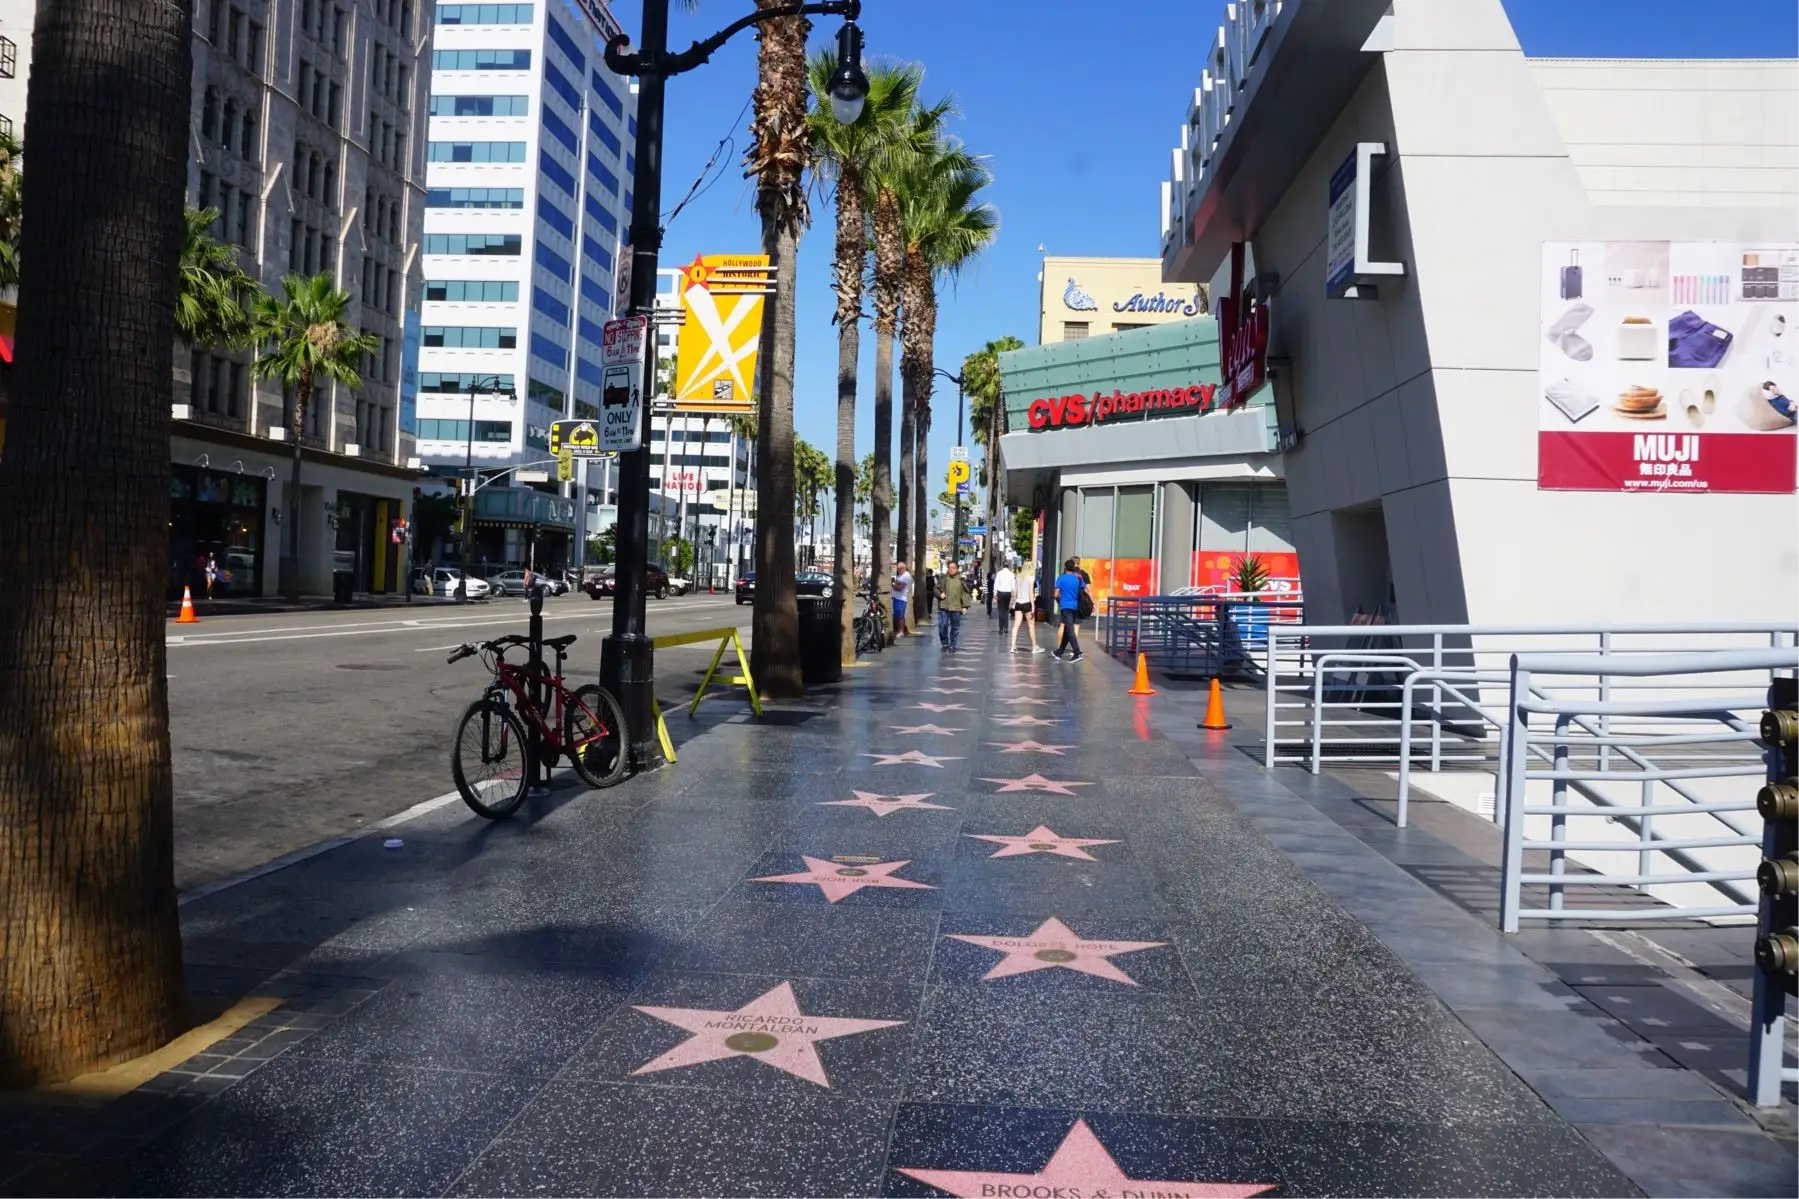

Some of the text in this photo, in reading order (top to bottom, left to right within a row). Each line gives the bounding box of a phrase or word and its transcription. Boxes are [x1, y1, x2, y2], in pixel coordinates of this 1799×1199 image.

[723, 259, 762, 267] HOLLYWOOD
[1113, 292, 1185, 314] Author
[607, 411, 632, 424] ONLY
[1634, 434, 1699, 462] MUJI
[673, 473, 694, 481] LIVE
[725, 1014, 804, 1026] RICARDO
[704, 1020, 818, 1035] MONTALBAN
[981, 1183, 1081, 1199] BROOKS
